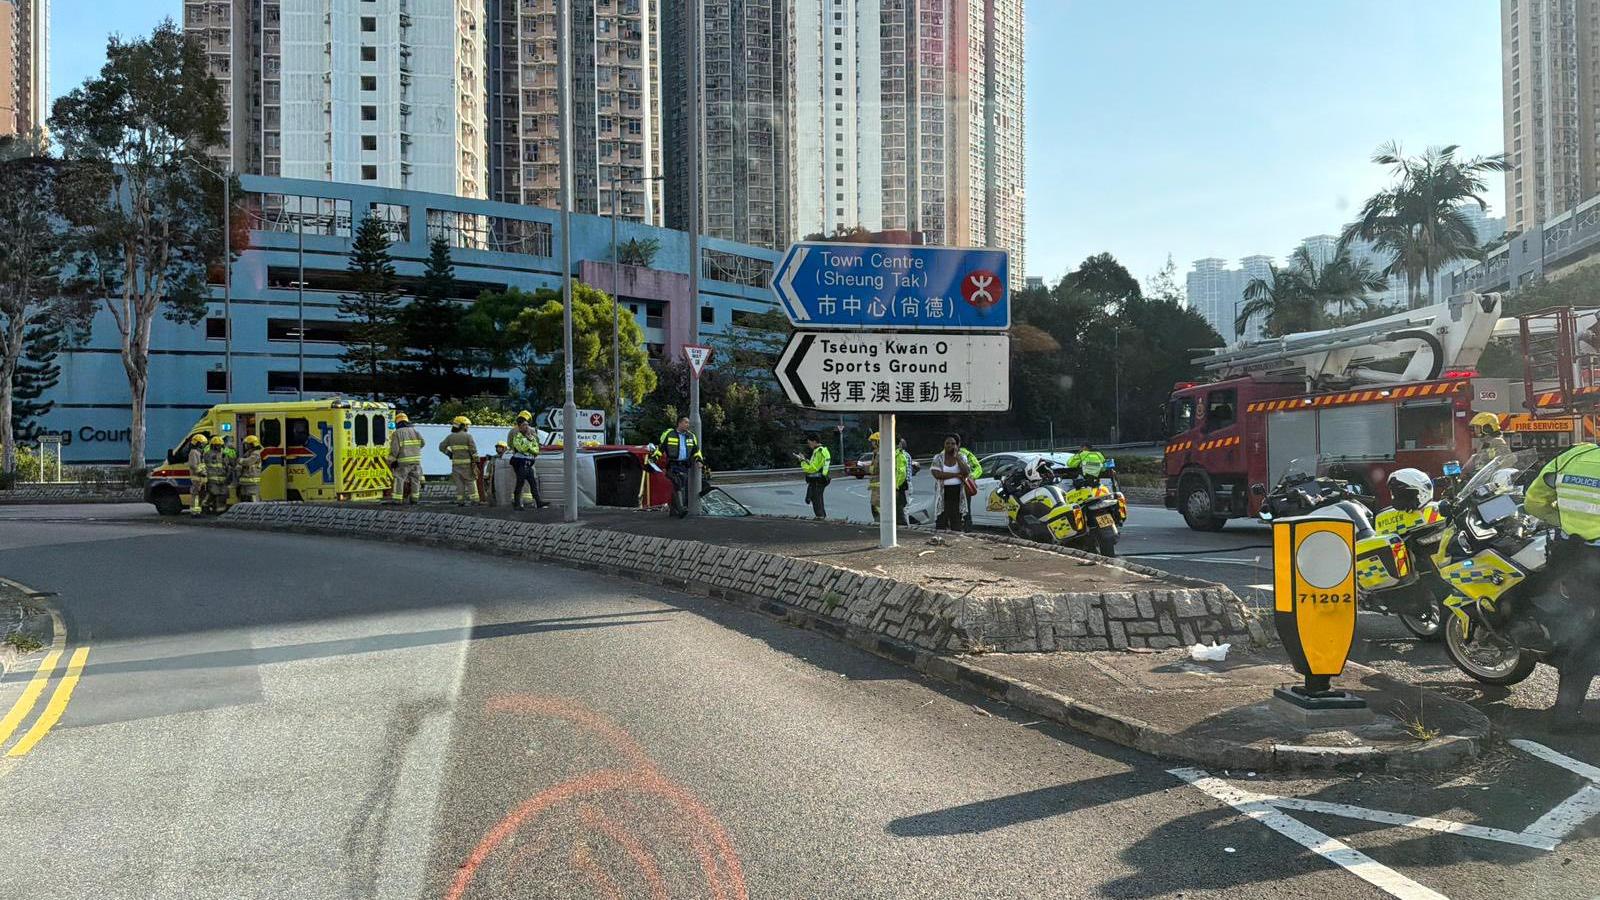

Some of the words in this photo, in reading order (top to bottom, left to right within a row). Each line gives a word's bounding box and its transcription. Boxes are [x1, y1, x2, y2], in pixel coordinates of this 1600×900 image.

[820, 251, 863, 267] Town
[871, 253, 924, 269] Centre
[816, 269, 884, 290] (Sheung
[891, 272, 927, 288] Tak)
[820, 339, 878, 357] Tseung
[885, 340, 928, 355] Kwan
[935, 341, 948, 355] O
[822, 358, 881, 375] Sports
[889, 359, 948, 374] Ground
[820, 380, 963, 403] 將軍澳運動場
[79, 426, 132, 442] Court
[1516, 422, 1532, 431] FIRE
[1533, 421, 1569, 430] SERVICES
[1571, 476, 1599, 487] POLICE
[1381, 515, 1400, 526] POLICE
[1298, 593, 1352, 604] 71202
